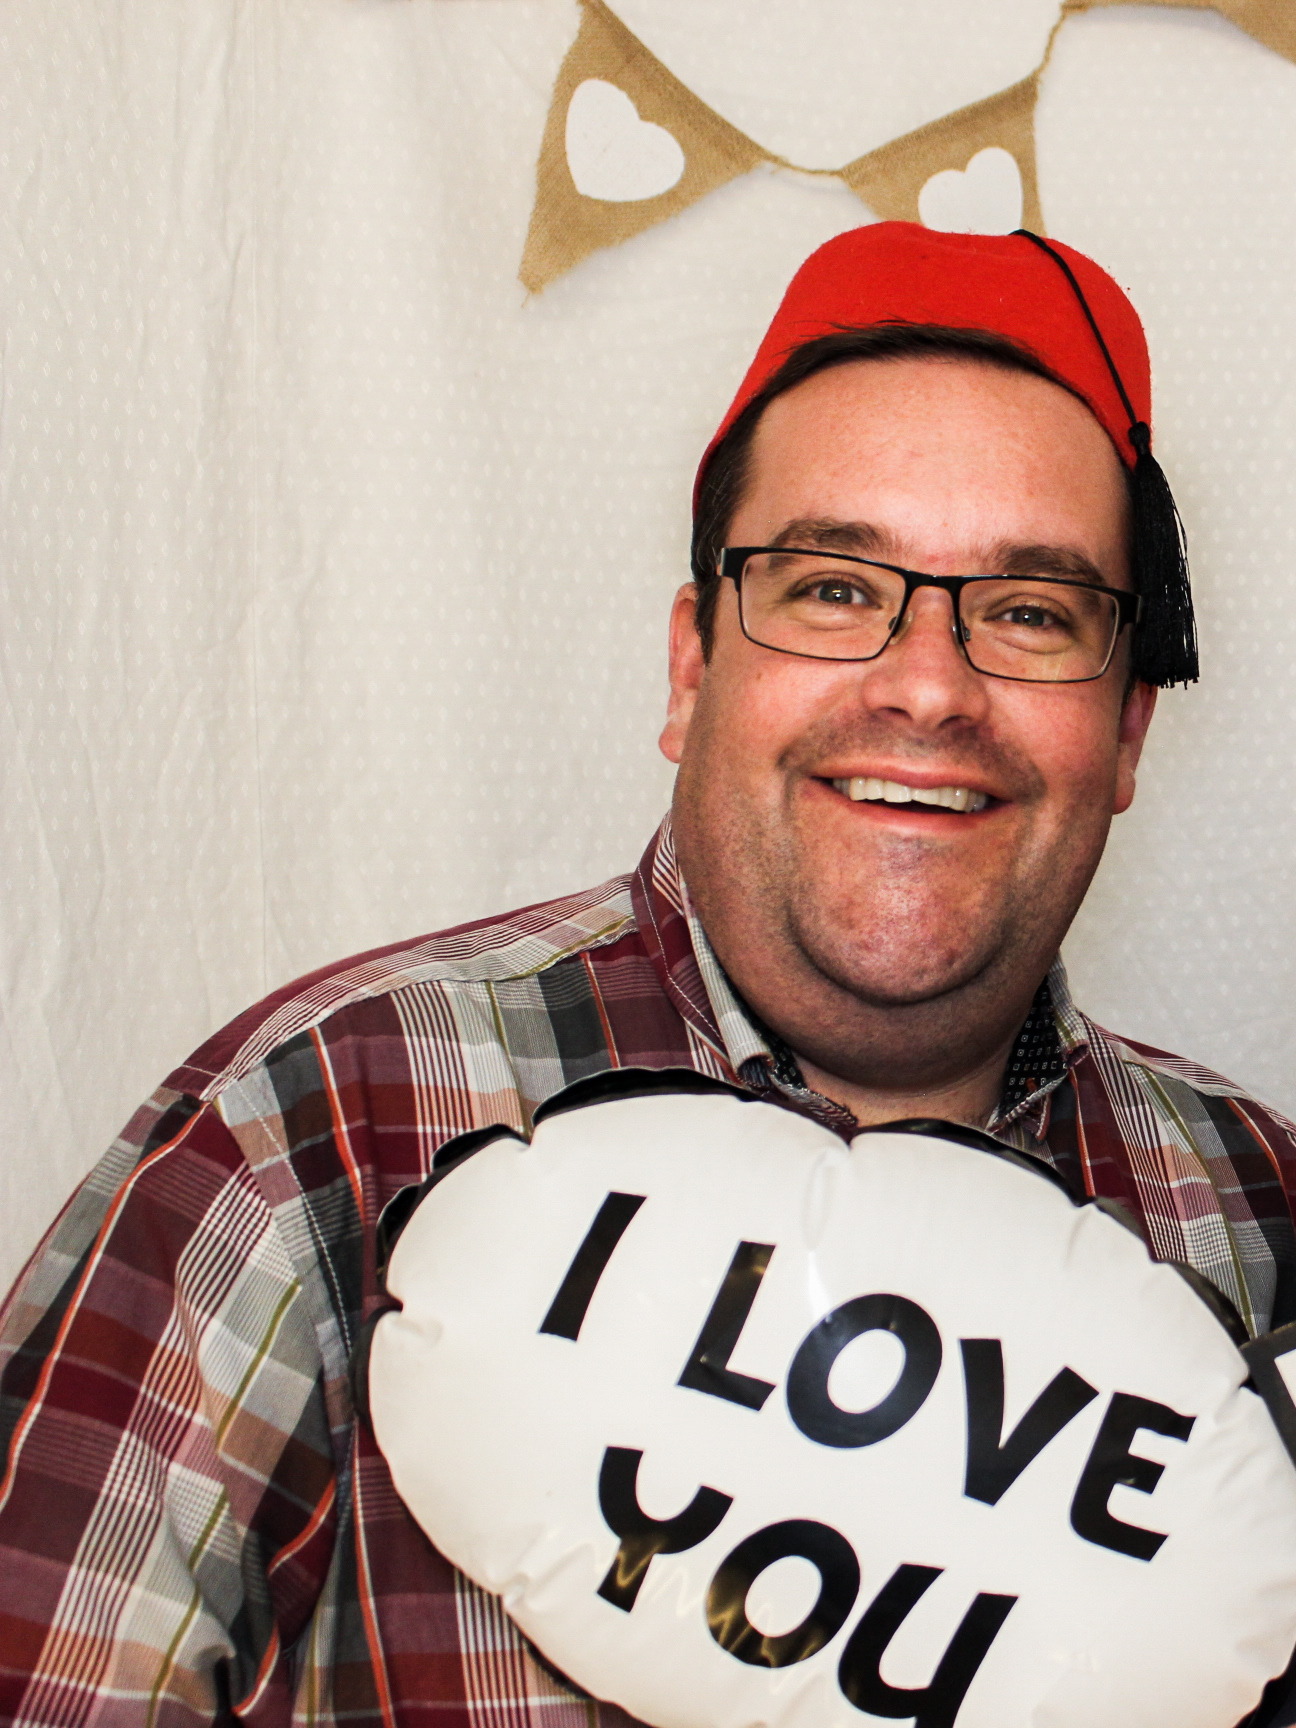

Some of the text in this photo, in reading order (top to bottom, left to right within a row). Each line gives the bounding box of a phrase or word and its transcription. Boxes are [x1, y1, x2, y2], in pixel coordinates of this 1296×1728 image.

[538, 1191, 1197, 1562] I LOVE
[597, 1446, 1020, 1728] YOU
